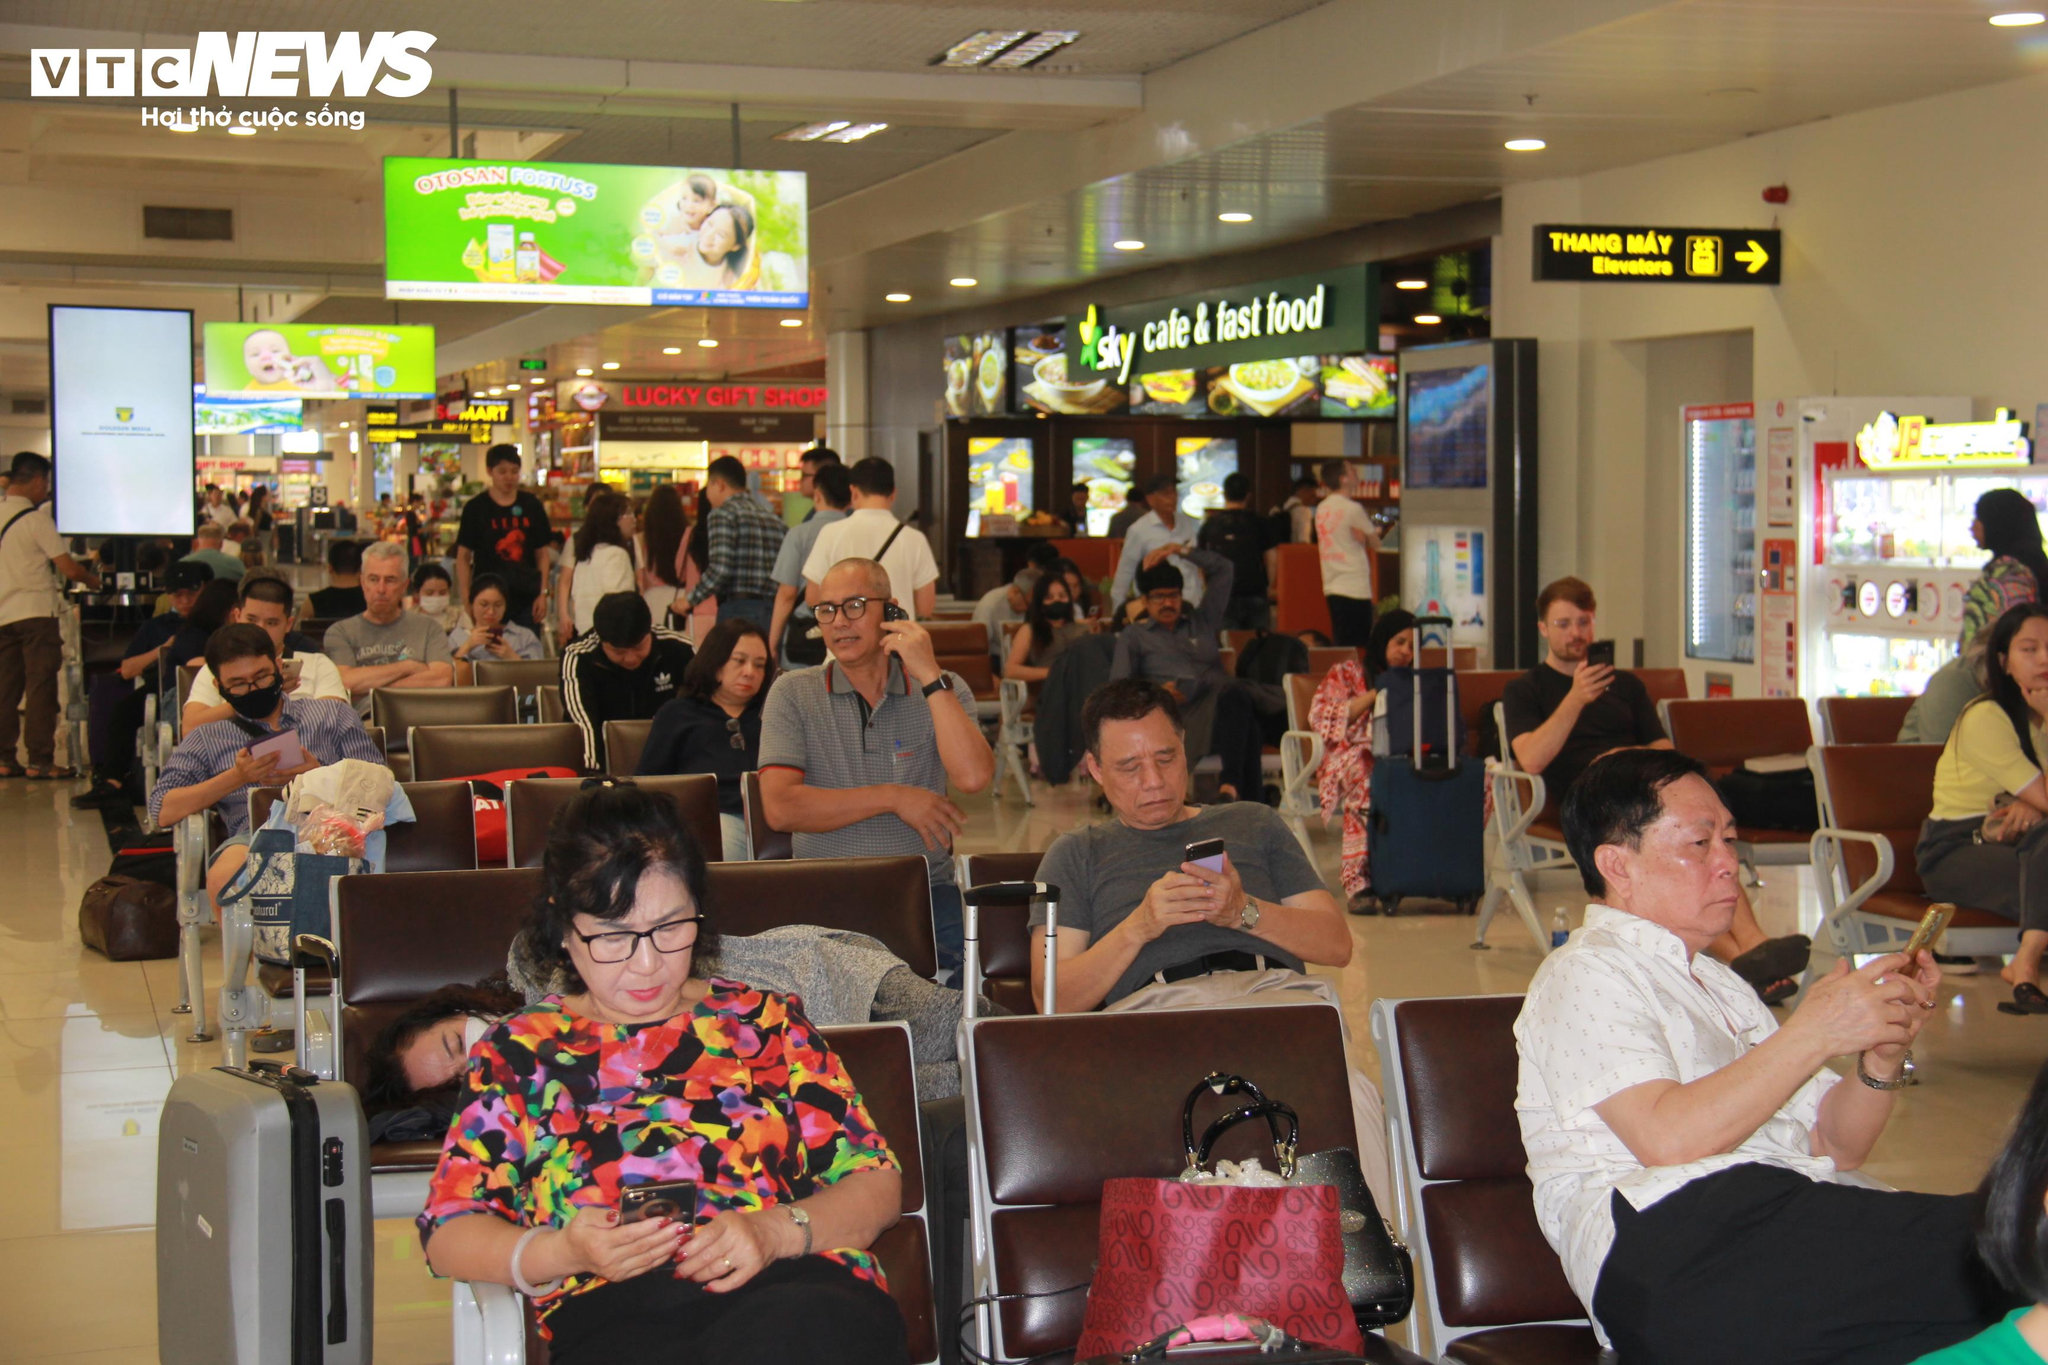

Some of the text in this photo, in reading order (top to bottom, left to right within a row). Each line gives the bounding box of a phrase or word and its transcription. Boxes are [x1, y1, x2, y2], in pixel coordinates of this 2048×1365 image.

[417, 167, 598, 200] OTOSAN FORTUSS
[1548, 229, 1673, 255] THANG MÁY
[1097, 284, 1326, 385] sky cafe & fast food
[622, 386, 829, 408] LUCKY GIFT SHOP
